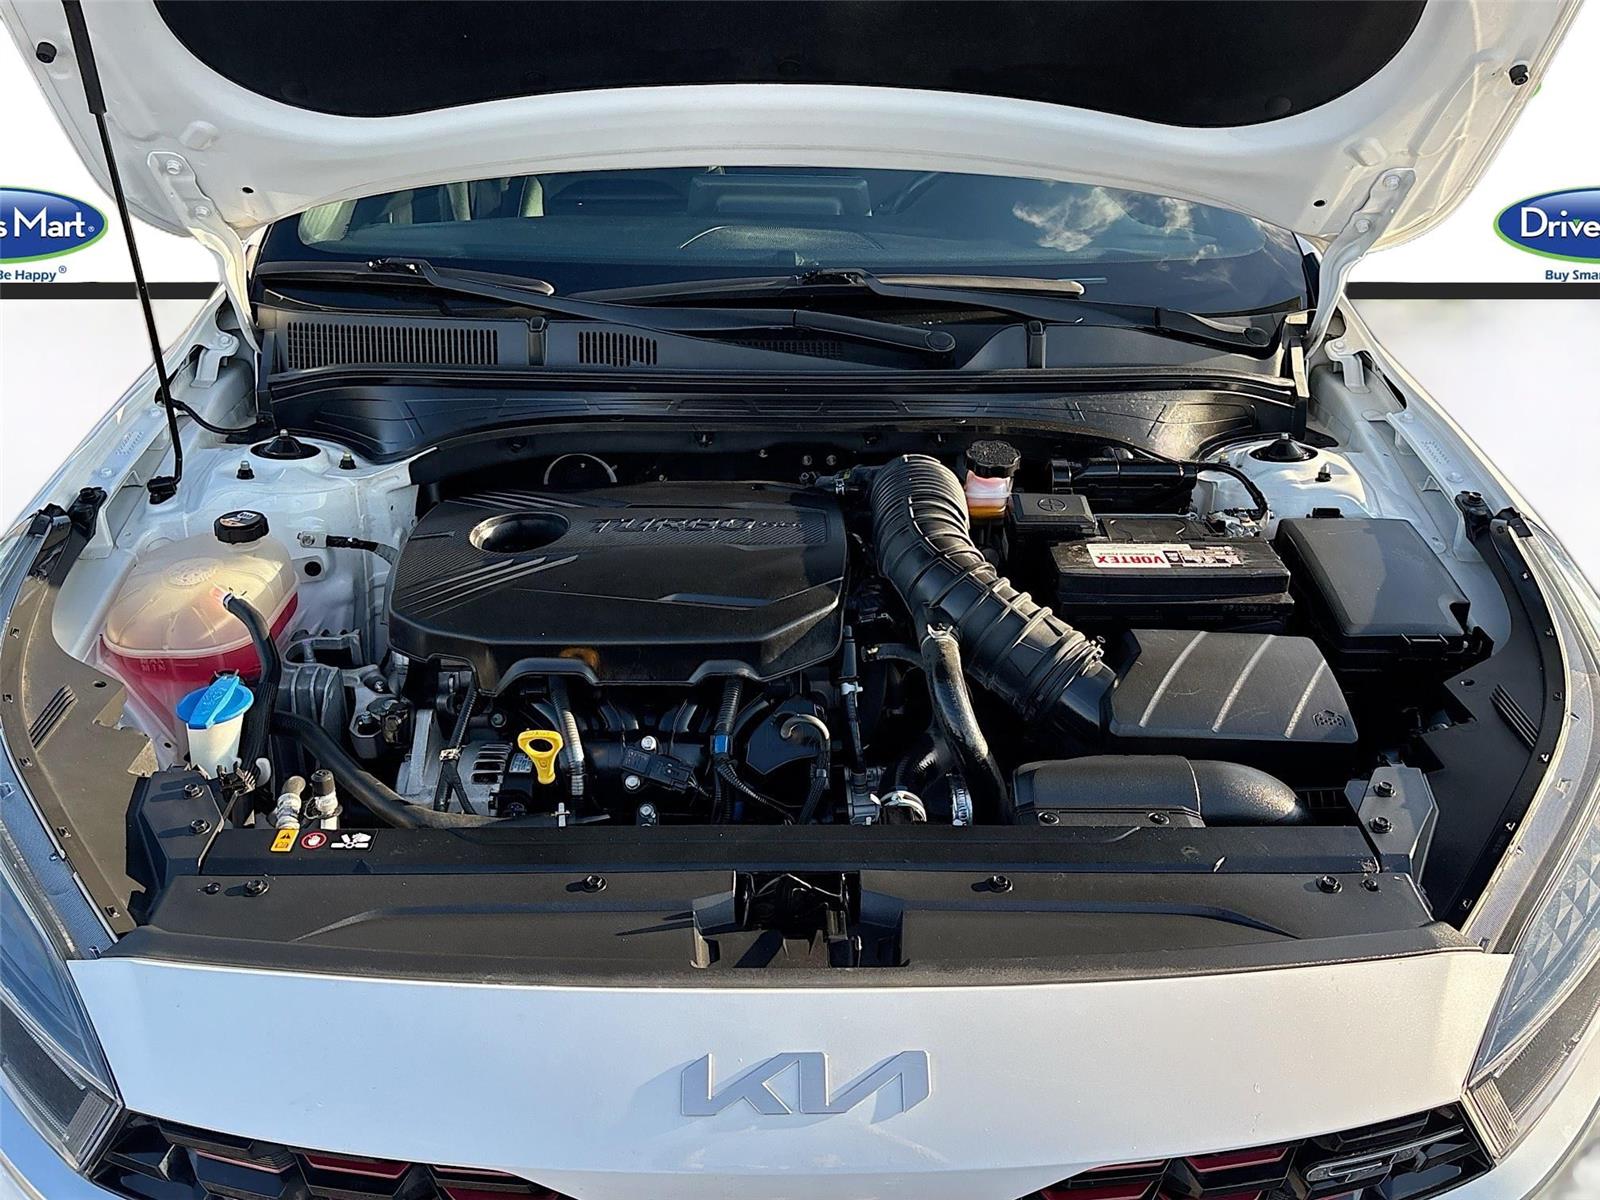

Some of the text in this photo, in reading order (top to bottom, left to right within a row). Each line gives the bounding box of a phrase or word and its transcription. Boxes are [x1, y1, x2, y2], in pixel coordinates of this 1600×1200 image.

[14, 206, 86, 238] Mart
[15, 269, 57, 282] Happy
[1545, 269, 1600, 282] Buy Sma
[591, 517, 757, 533] TURBO
[1097, 555, 1166, 565] VORTEX
[681, 1050, 932, 1117] KIA
